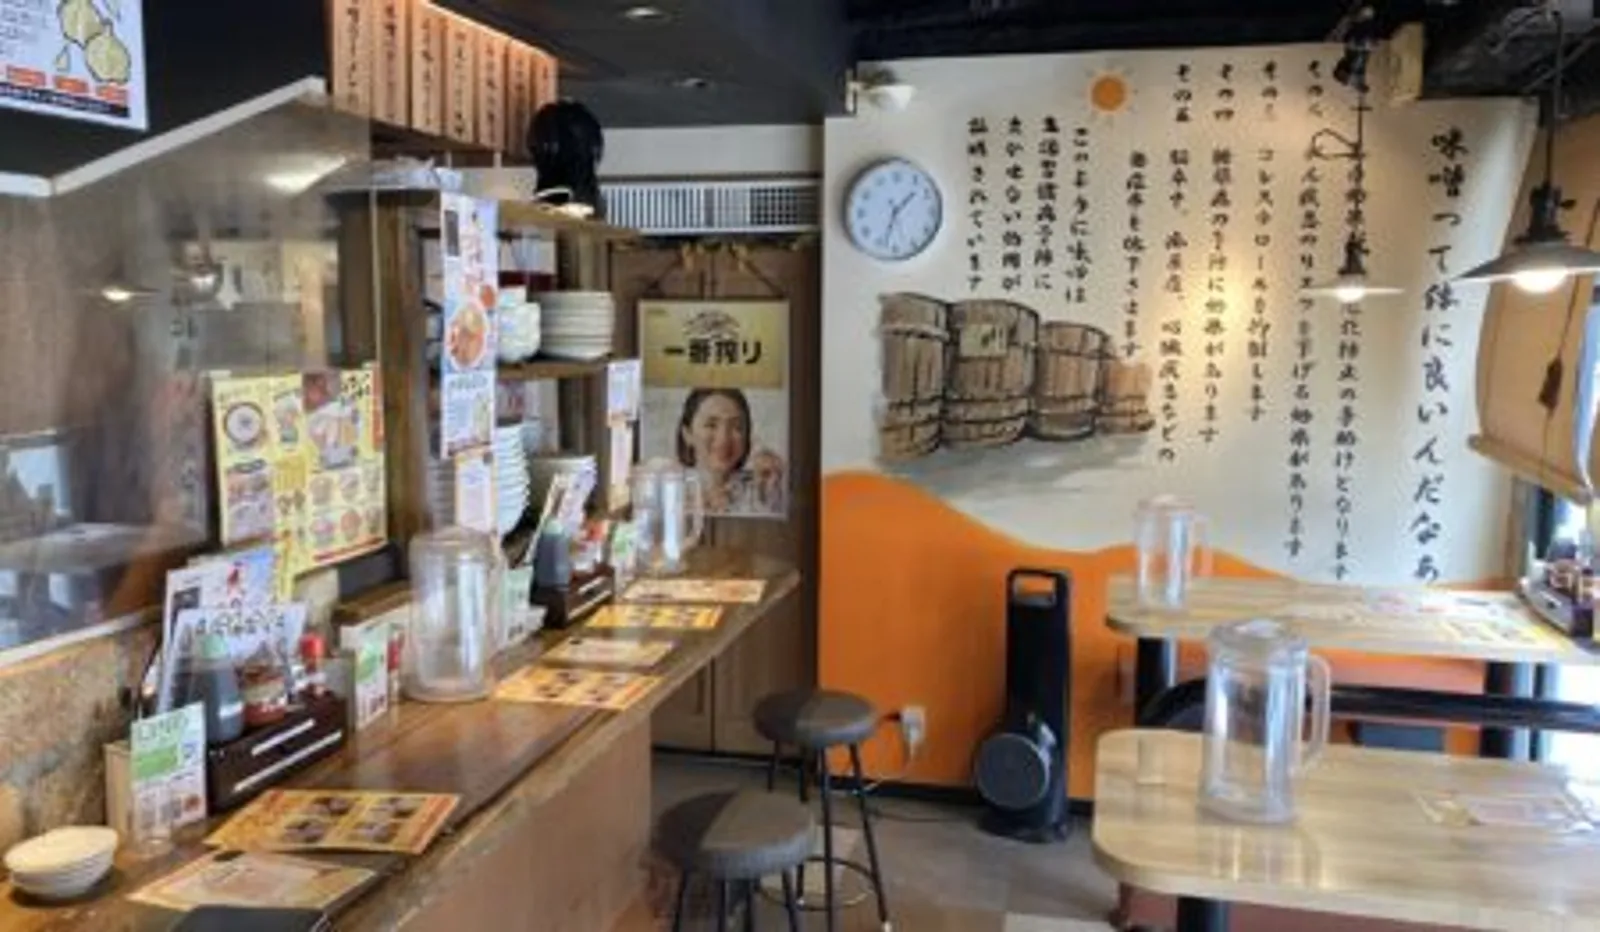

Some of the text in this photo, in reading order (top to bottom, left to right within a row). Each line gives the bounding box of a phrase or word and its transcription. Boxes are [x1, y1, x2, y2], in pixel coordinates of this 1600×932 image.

[967, 116, 989, 291] 証明されています
[1035, 116, 1060, 290] 生活習慣病予防に
[1065, 127, 1091, 304] このように味噌は
[663, 338, 763, 365] 一番搾り
